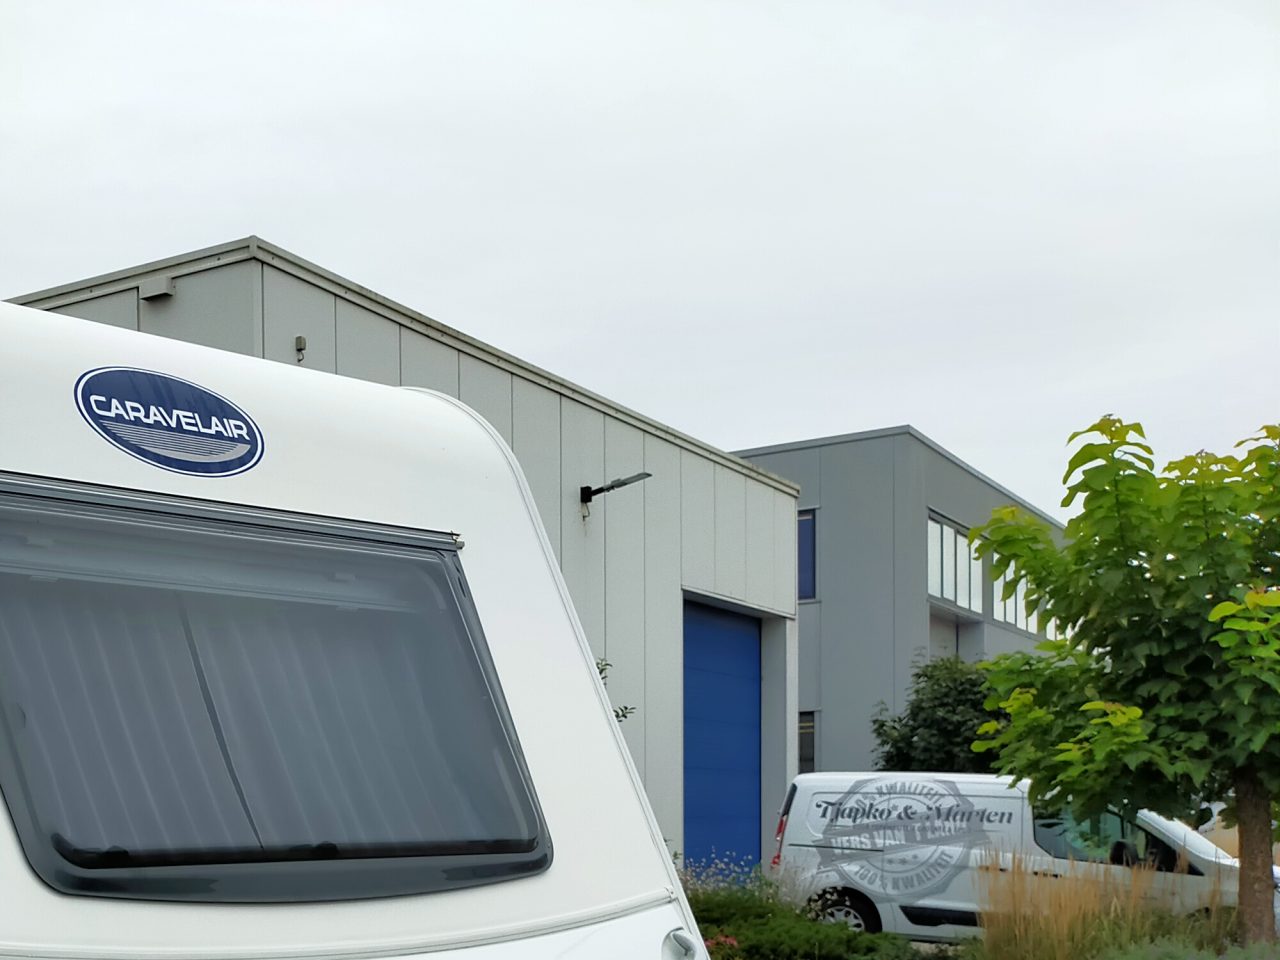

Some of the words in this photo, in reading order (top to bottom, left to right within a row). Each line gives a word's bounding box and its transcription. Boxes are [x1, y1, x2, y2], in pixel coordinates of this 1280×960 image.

[89, 394, 251, 441] CARAVELAIR
[896, 804, 918, 821] &
[830, 832, 872, 855] VERS
[872, 826, 906, 848] VAN
[891, 850, 954, 891] KWALITEIT
